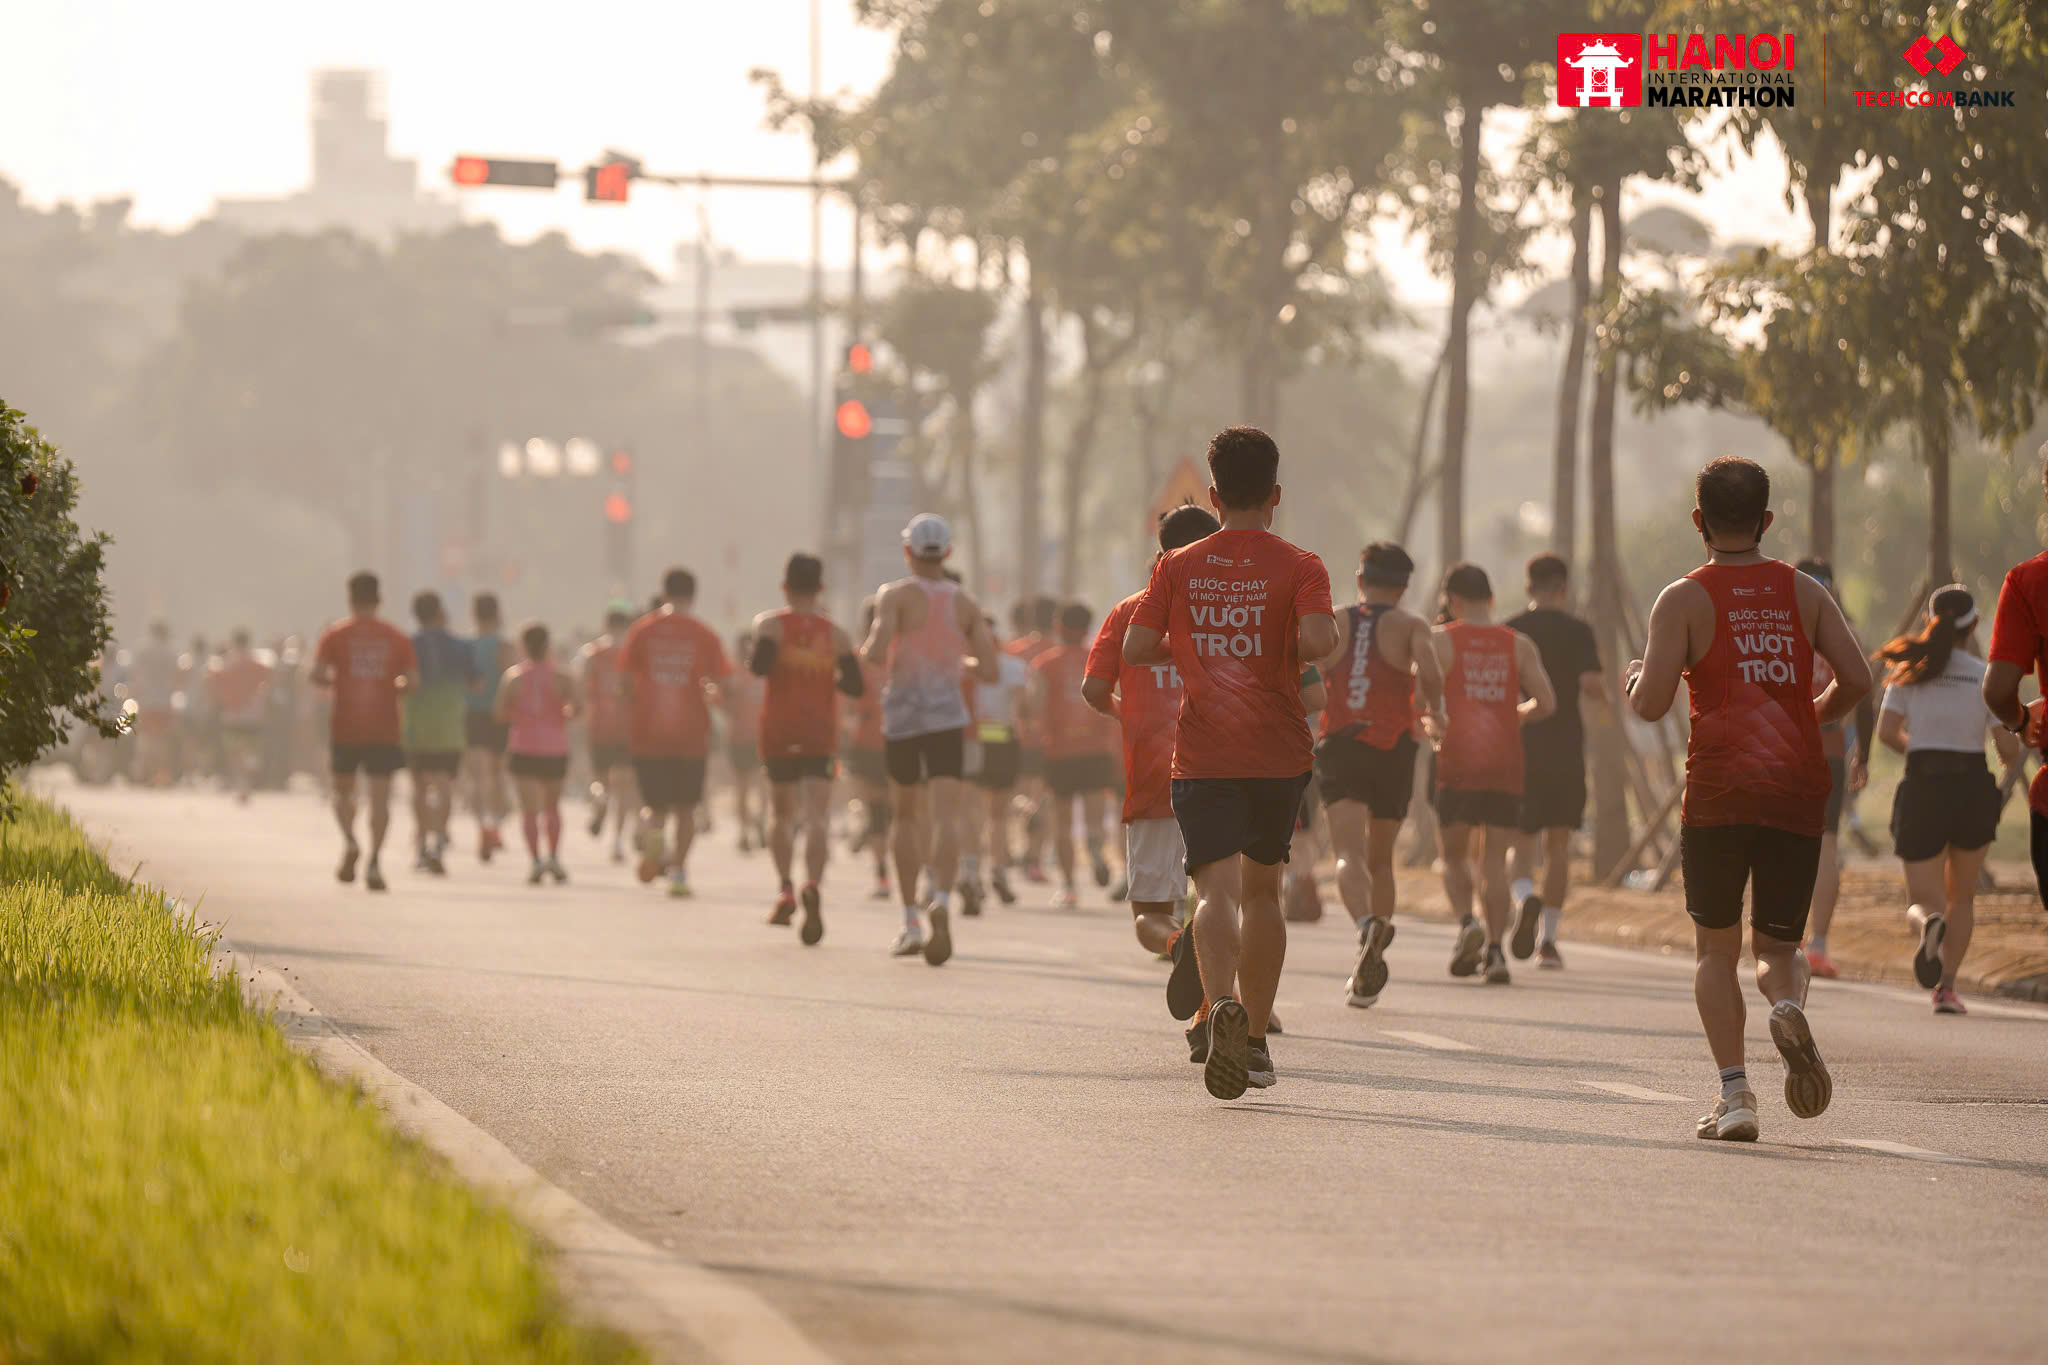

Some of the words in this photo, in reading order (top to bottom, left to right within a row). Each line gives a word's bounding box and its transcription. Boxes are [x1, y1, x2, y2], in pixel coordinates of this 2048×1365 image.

[1189, 577, 1228, 591] BƯỚC
[1223, 592, 1244, 604] VIỆT
[1246, 592, 1267, 601] NAM
[1190, 603, 1265, 632] VƯỢT
[1191, 631, 1262, 660] TRỘI
[1733, 631, 1794, 658] VƯỢT
